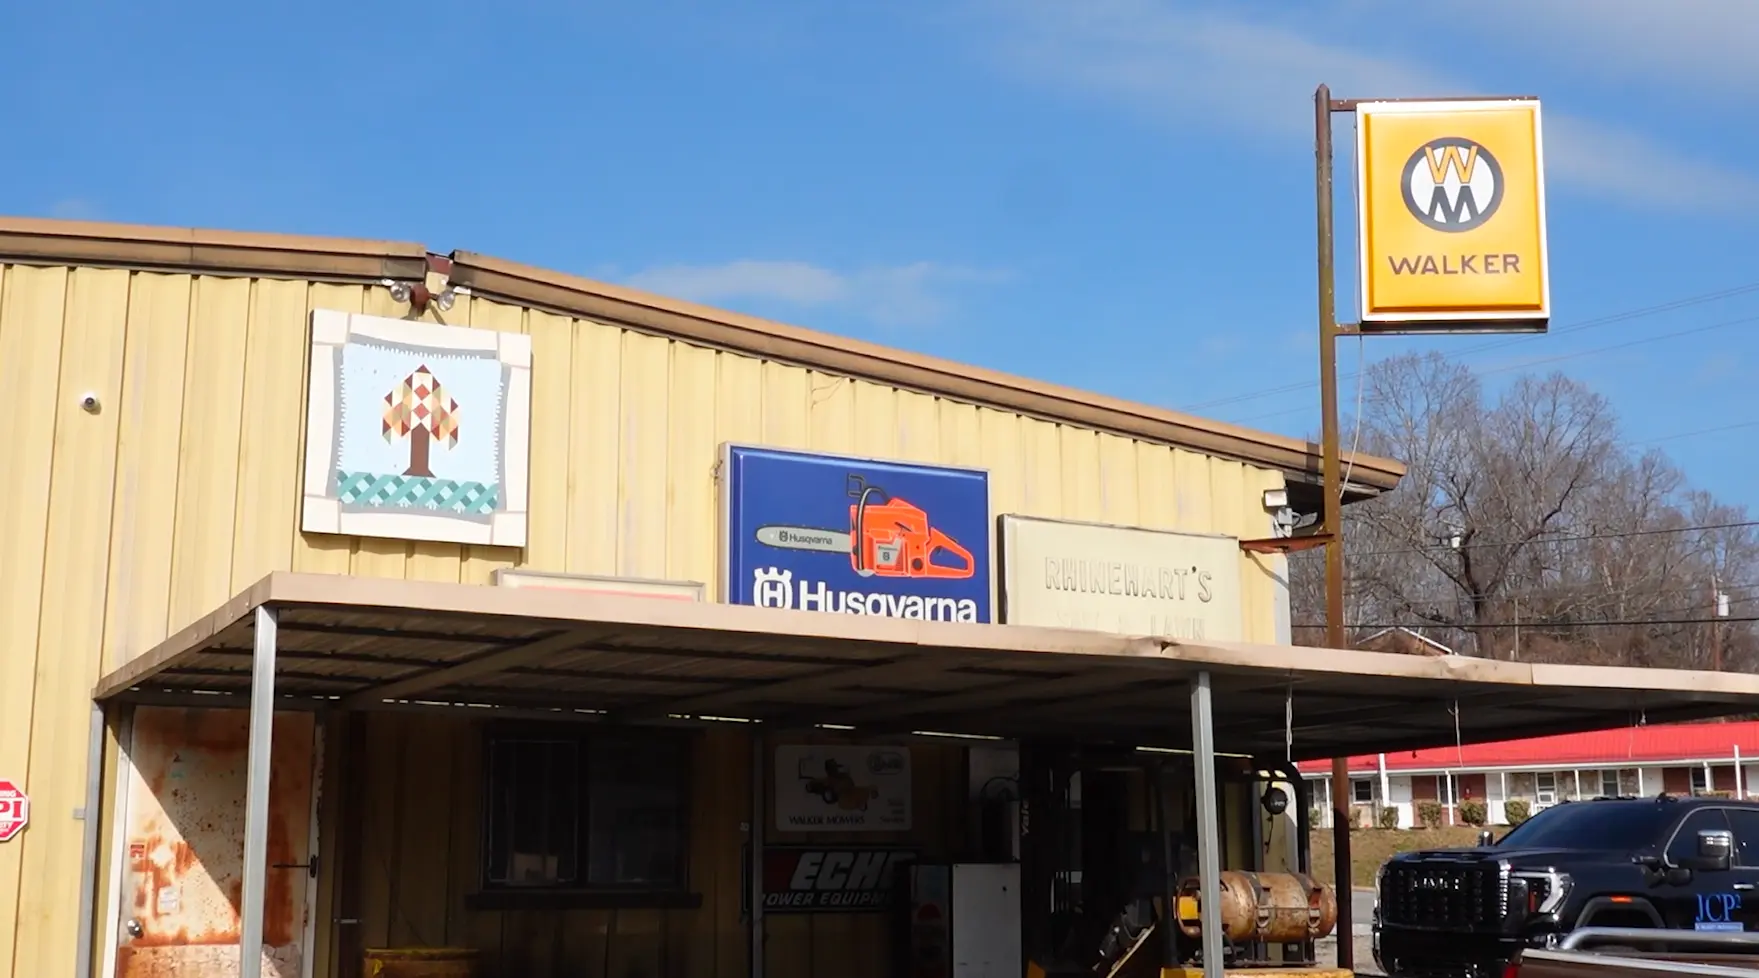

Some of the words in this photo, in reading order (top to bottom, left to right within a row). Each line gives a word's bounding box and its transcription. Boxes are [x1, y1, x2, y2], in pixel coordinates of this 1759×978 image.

[1387, 253, 1522, 275] WALKER
[789, 533, 833, 546] Husqvarna
[1044, 556, 1214, 604] RHINEHART'S
[799, 580, 977, 624] Husqvarna
[763, 892, 814, 906] OWER
